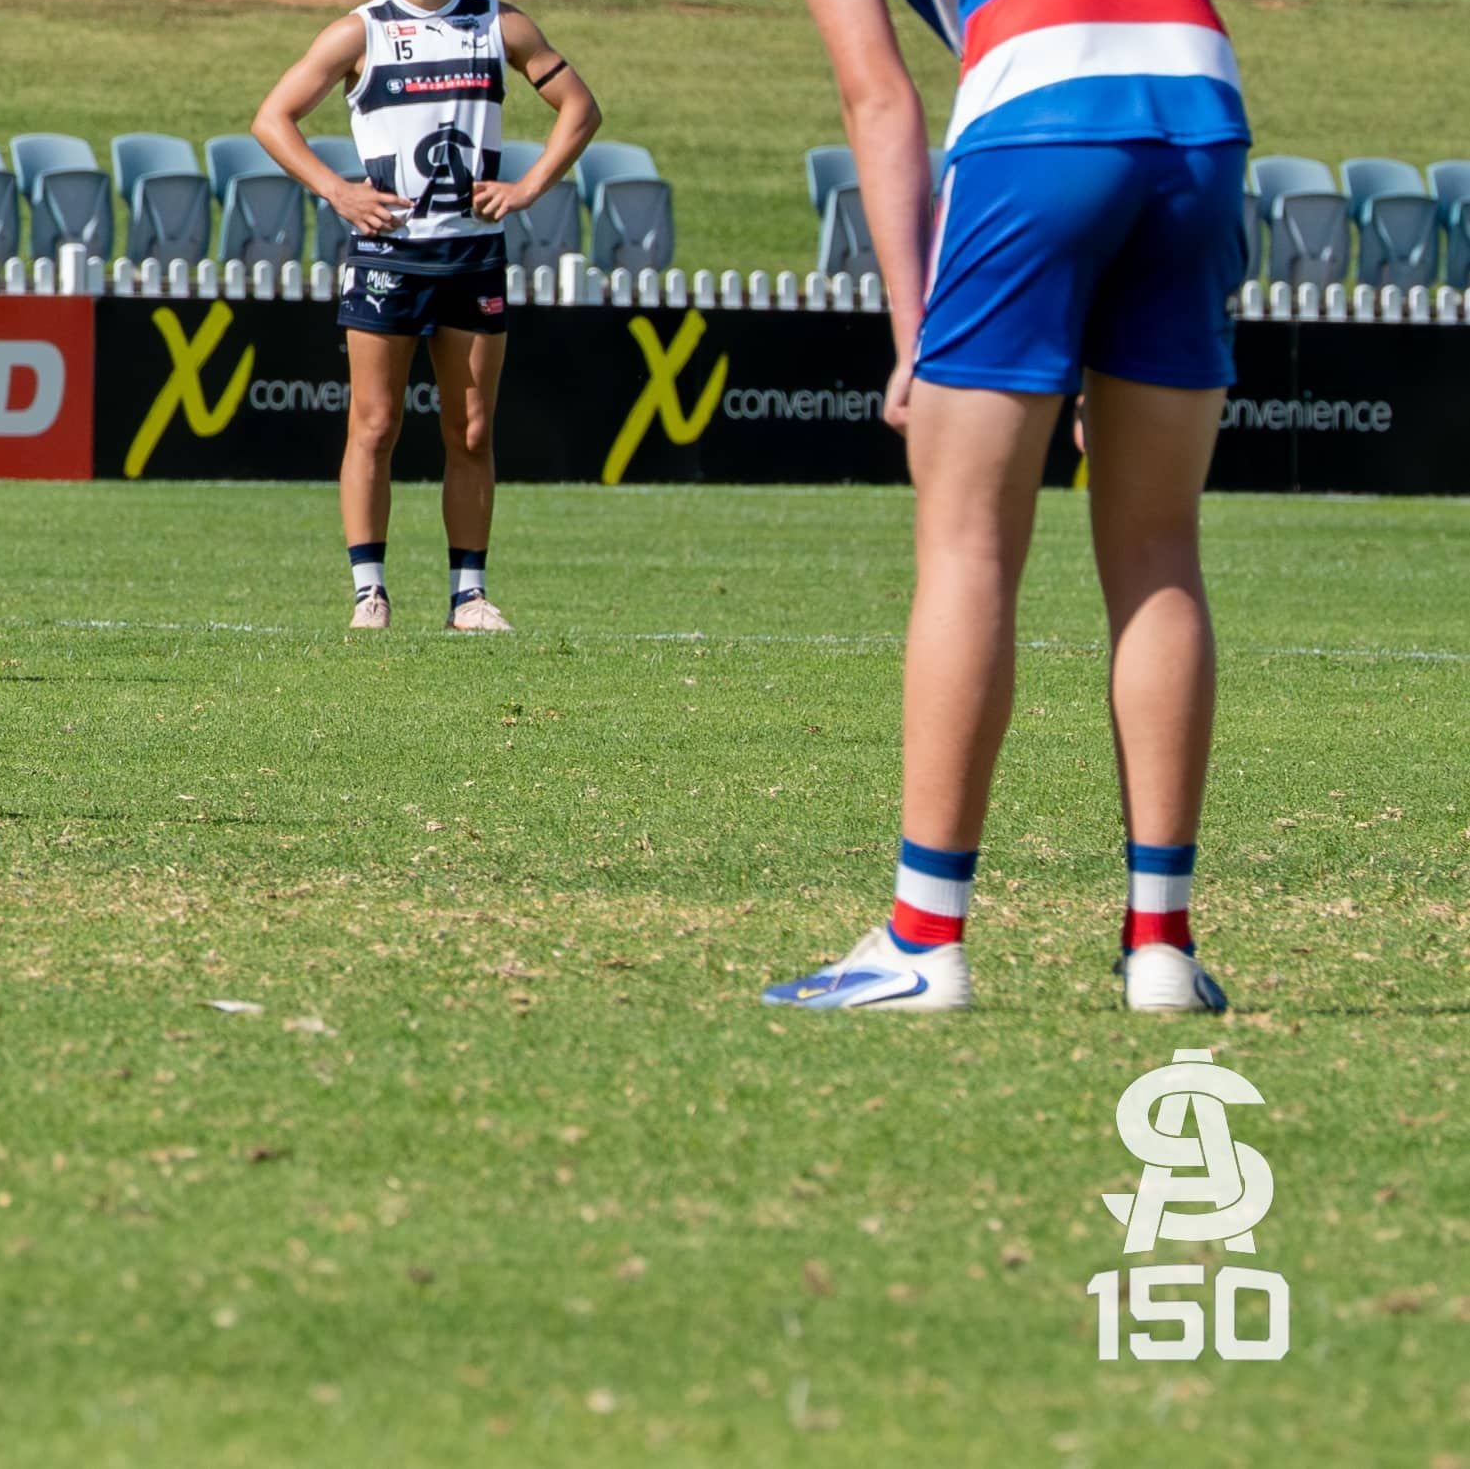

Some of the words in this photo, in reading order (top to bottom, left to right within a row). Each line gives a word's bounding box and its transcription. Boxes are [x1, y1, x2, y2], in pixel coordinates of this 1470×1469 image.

[394, 40, 414, 61] 15
[723, 380, 886, 421] convenien
[1219, 390, 1392, 431] onvenience
